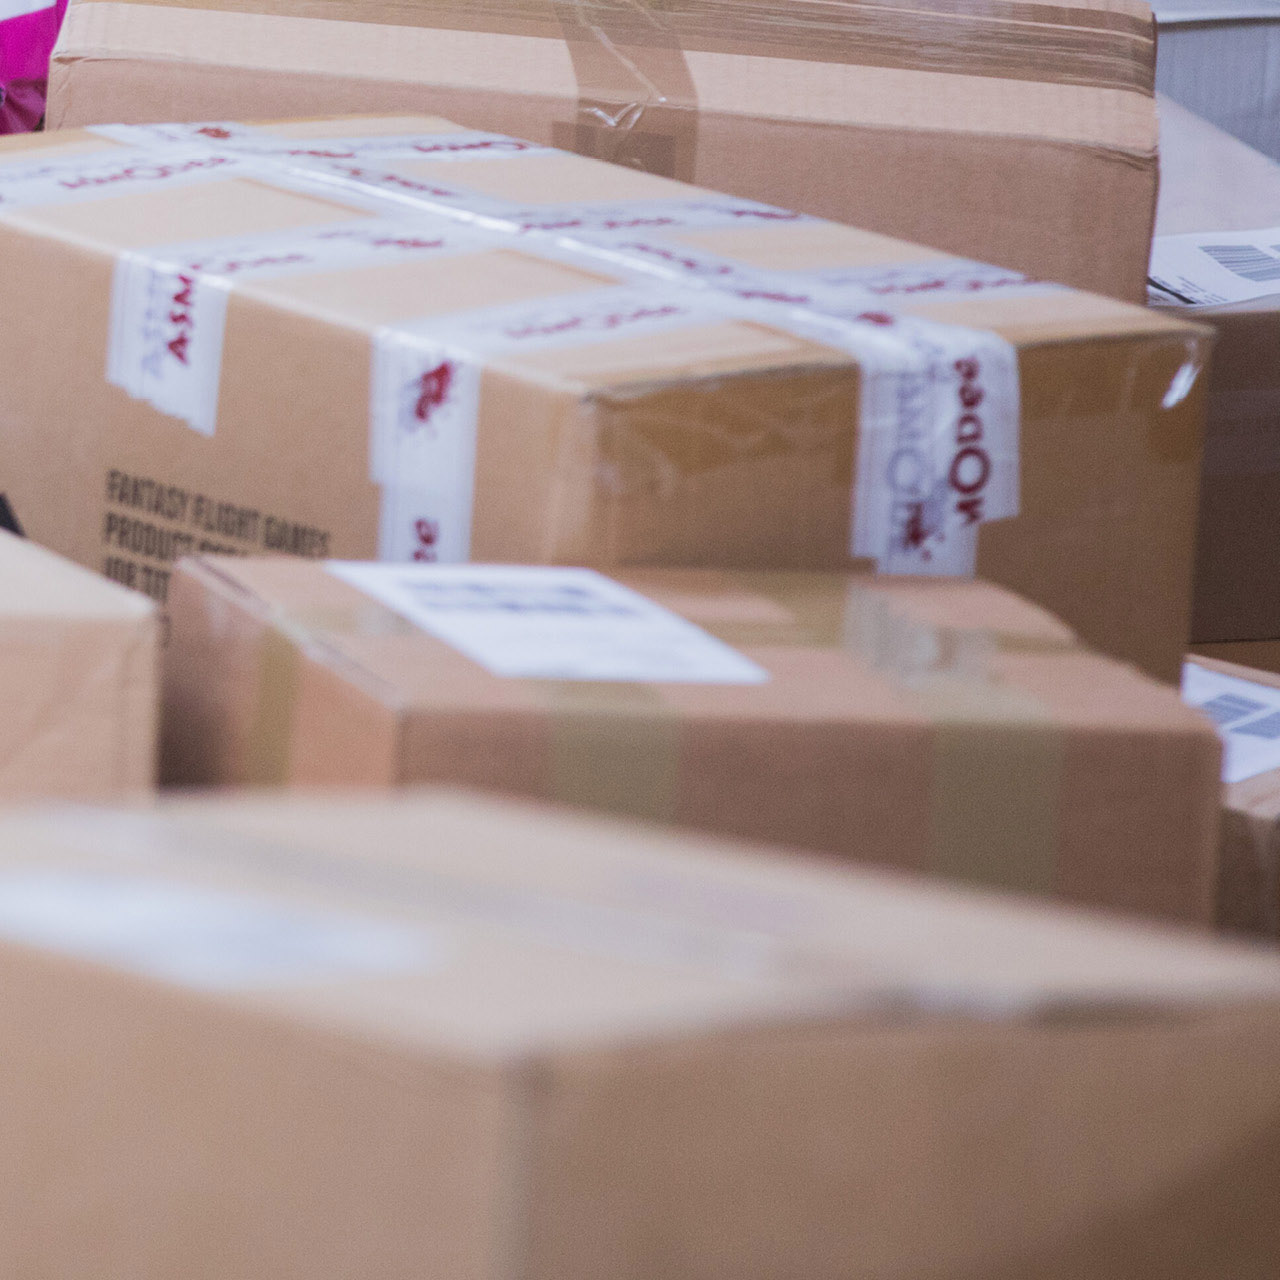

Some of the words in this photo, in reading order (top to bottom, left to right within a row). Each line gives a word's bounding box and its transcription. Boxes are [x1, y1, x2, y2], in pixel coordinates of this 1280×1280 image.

[103, 512, 186, 561] PRODUCT
[104, 469, 190, 523] FANTASY
[192, 494, 259, 542] FLIGHT
[263, 511, 331, 558] GAMES
